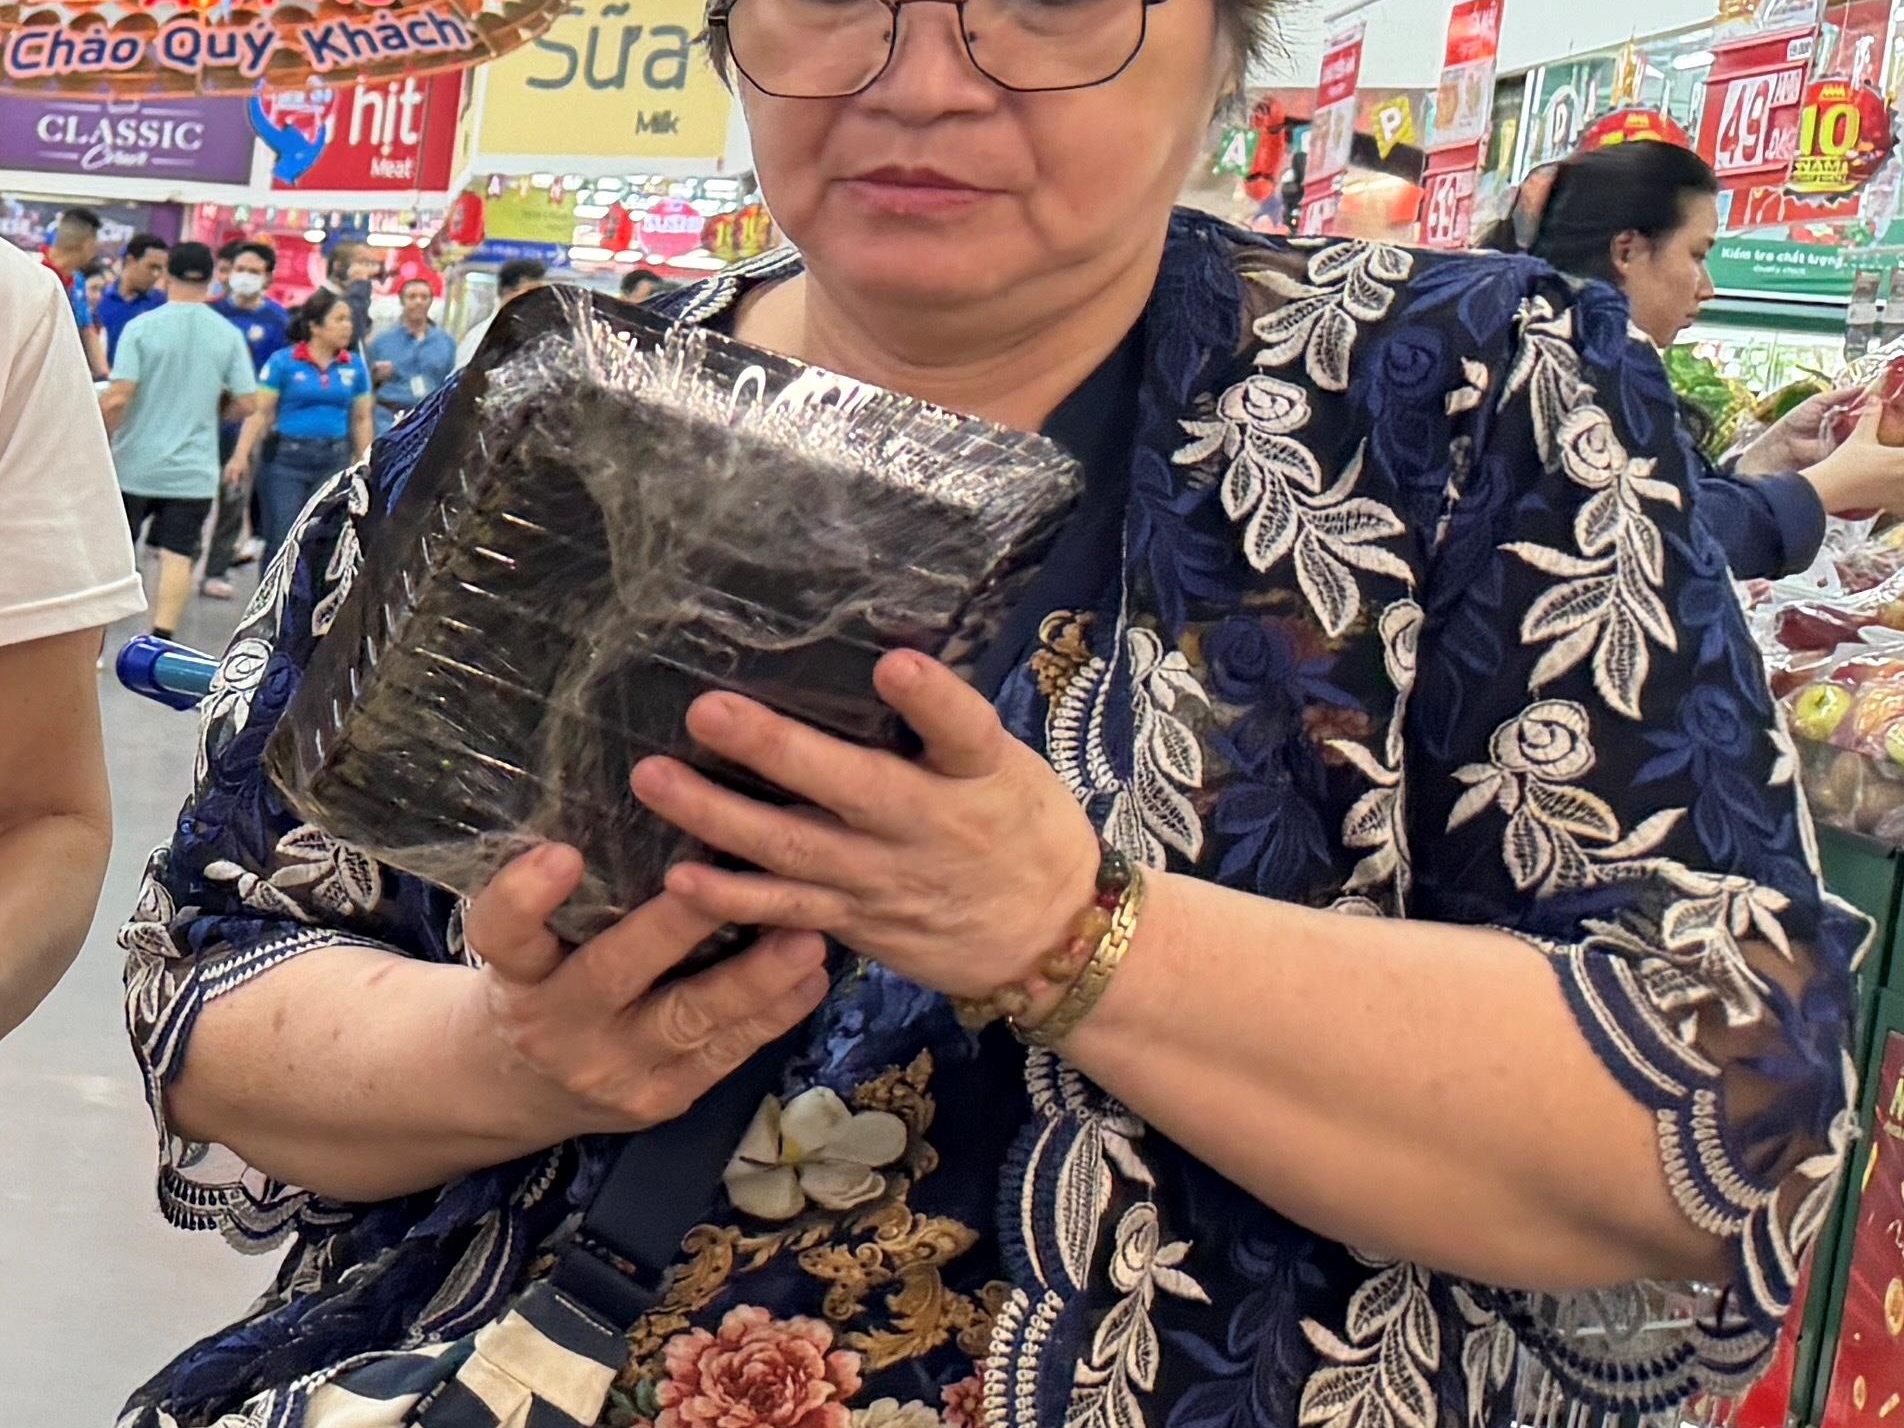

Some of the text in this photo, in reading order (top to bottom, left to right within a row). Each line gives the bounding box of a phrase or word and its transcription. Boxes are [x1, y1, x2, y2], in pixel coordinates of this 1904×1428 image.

[11, 8, 469, 71] Chào Quý Khách
[525, 2, 690, 90] Sữa
[37, 113, 205, 151] CLASSIC
[323, 75, 424, 157] hịt
[635, 110, 679, 134] Milk
[1801, 103, 1860, 157] 10
[369, 157, 414, 179] Meat
